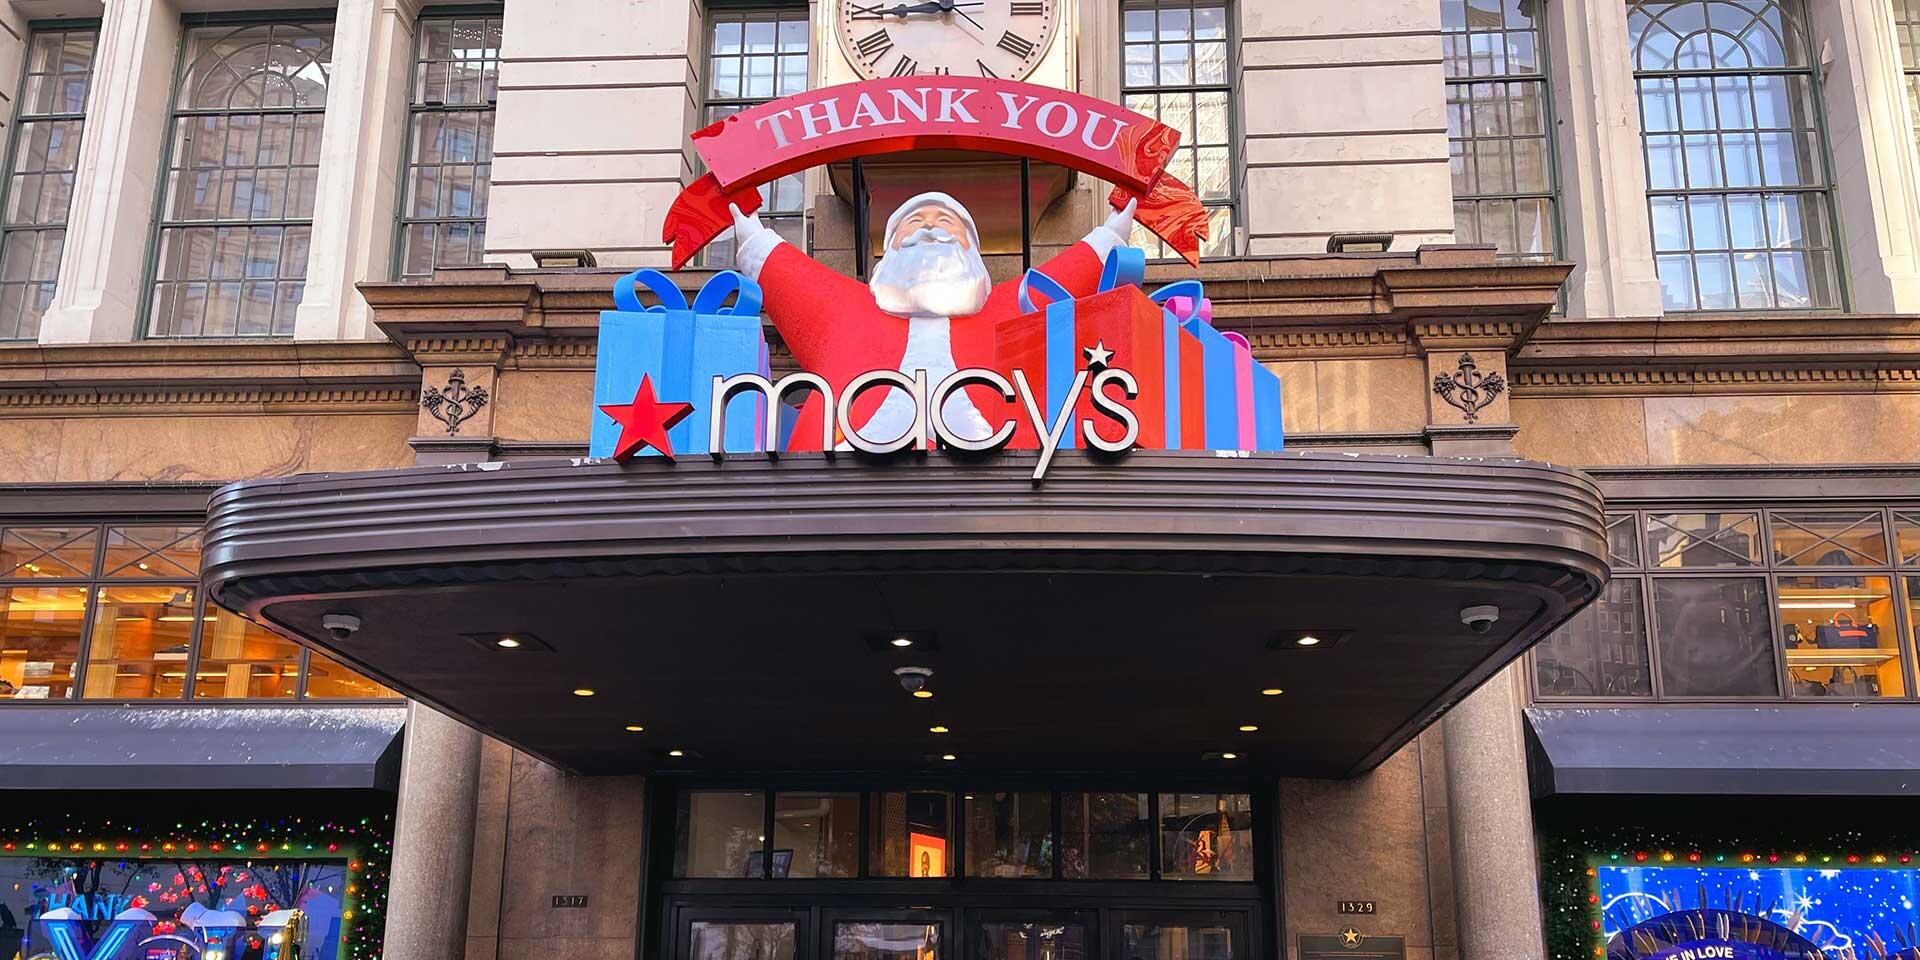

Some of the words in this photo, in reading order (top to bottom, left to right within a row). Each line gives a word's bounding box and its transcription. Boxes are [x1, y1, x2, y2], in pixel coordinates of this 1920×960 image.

[756, 87, 979, 149] THANK
[996, 92, 1128, 151] YOU
[711, 341, 1138, 486] macy's
[1342, 903, 1373, 912] 1329
[1697, 946, 1734, 959] LOVE
